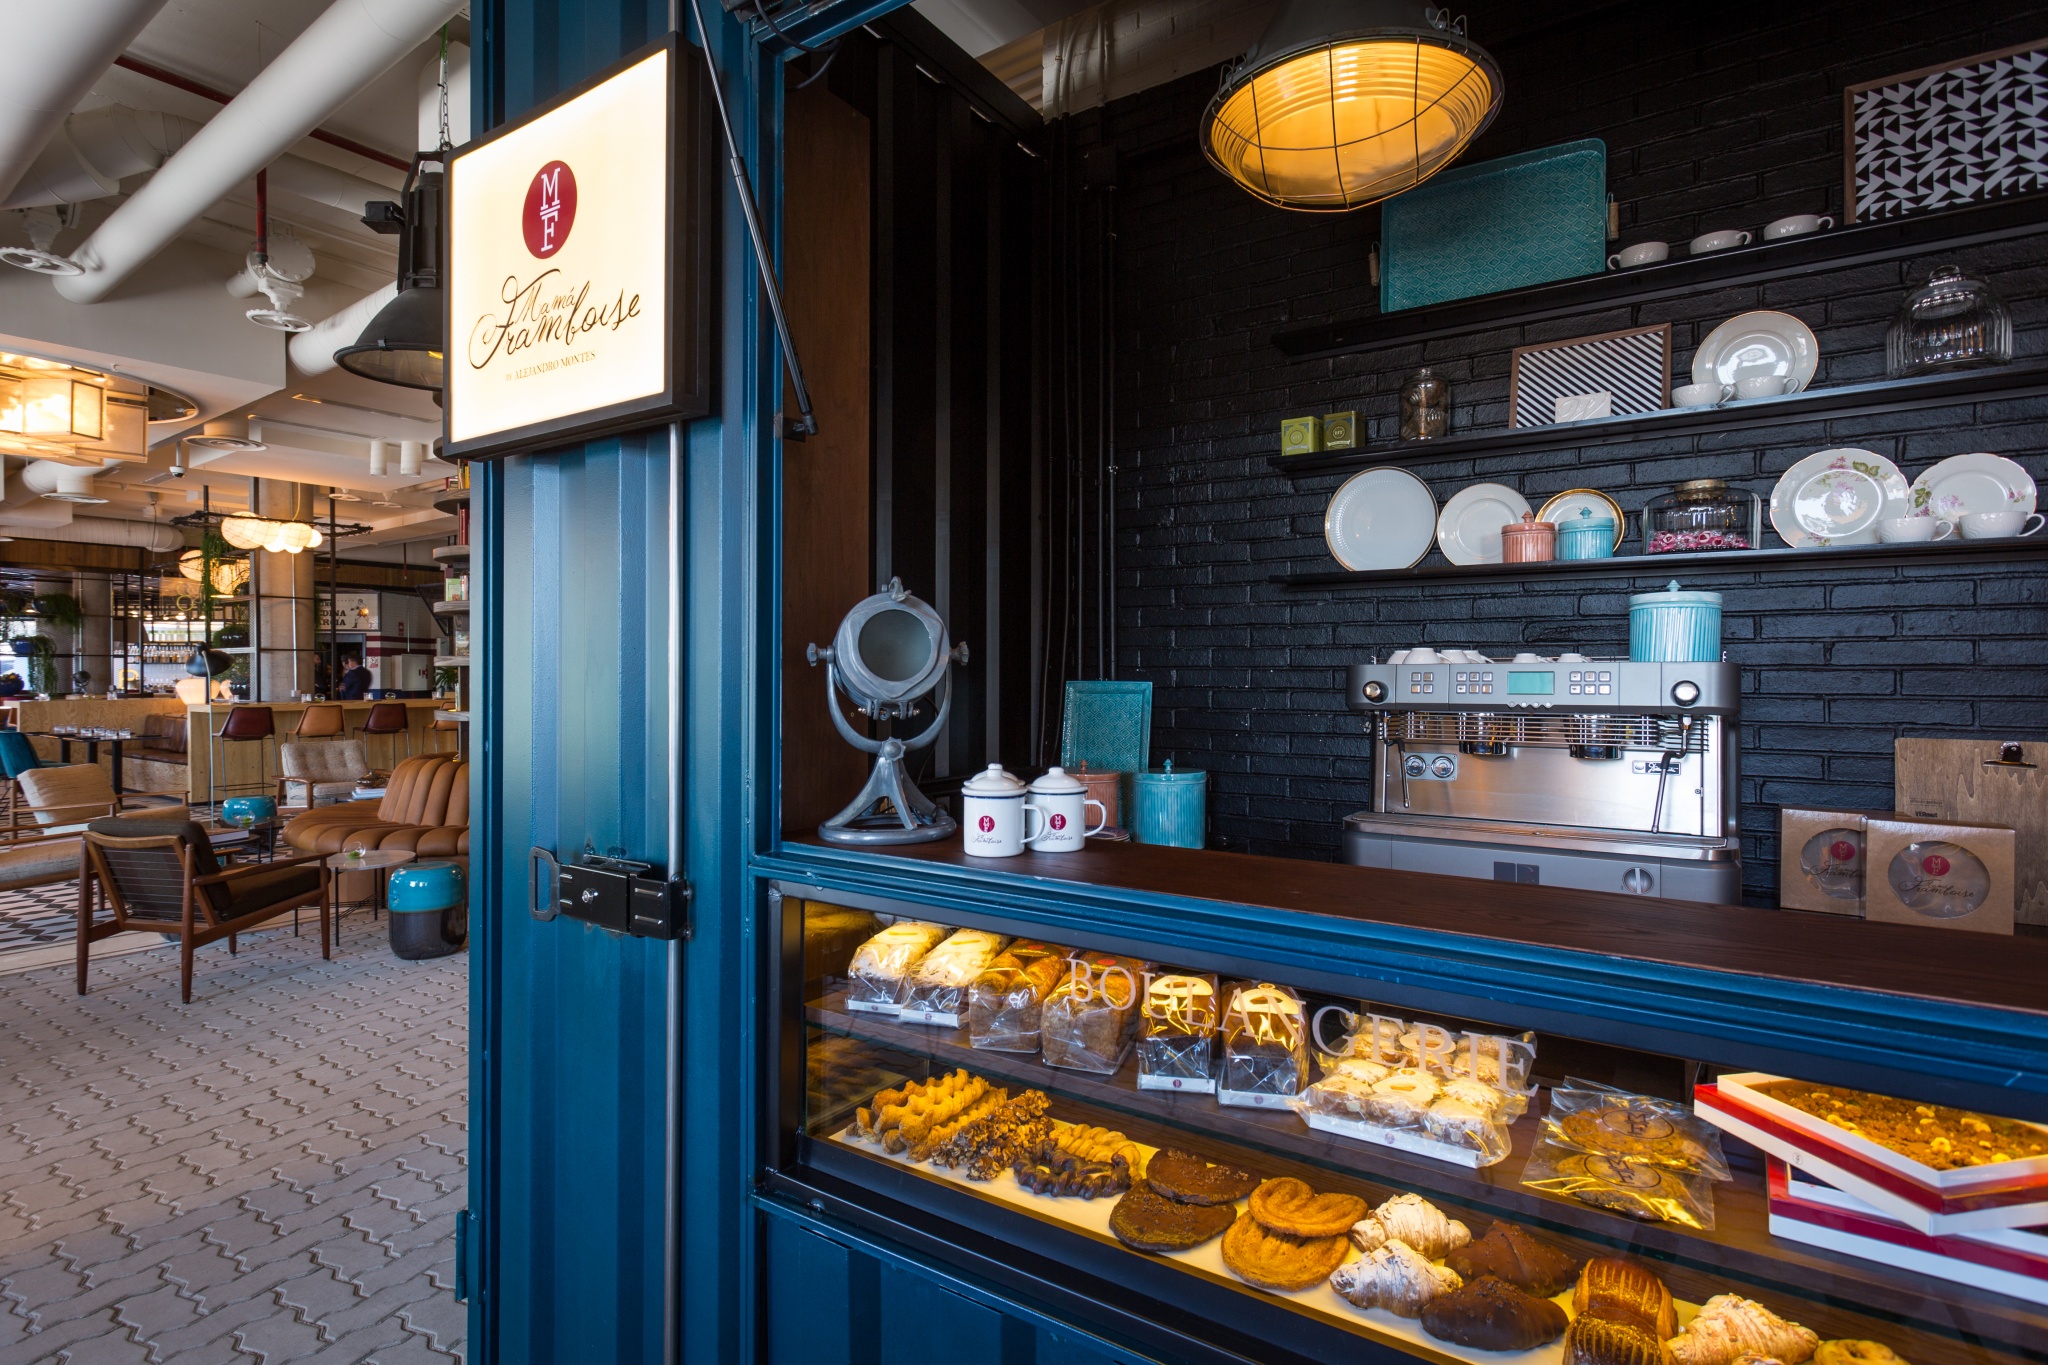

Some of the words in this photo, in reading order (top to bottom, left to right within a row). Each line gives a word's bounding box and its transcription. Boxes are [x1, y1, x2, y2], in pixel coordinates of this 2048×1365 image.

[540, 167, 561, 211] M
[540, 210, 559, 252] F
[469, 268, 641, 370] Framboise
[514, 359, 559, 380] ALEJANDRO
[560, 350, 596, 367] MONTES
[1898, 876, 1975, 898] Framboise
[1061, 957, 1540, 1098] BOULANGERIE
